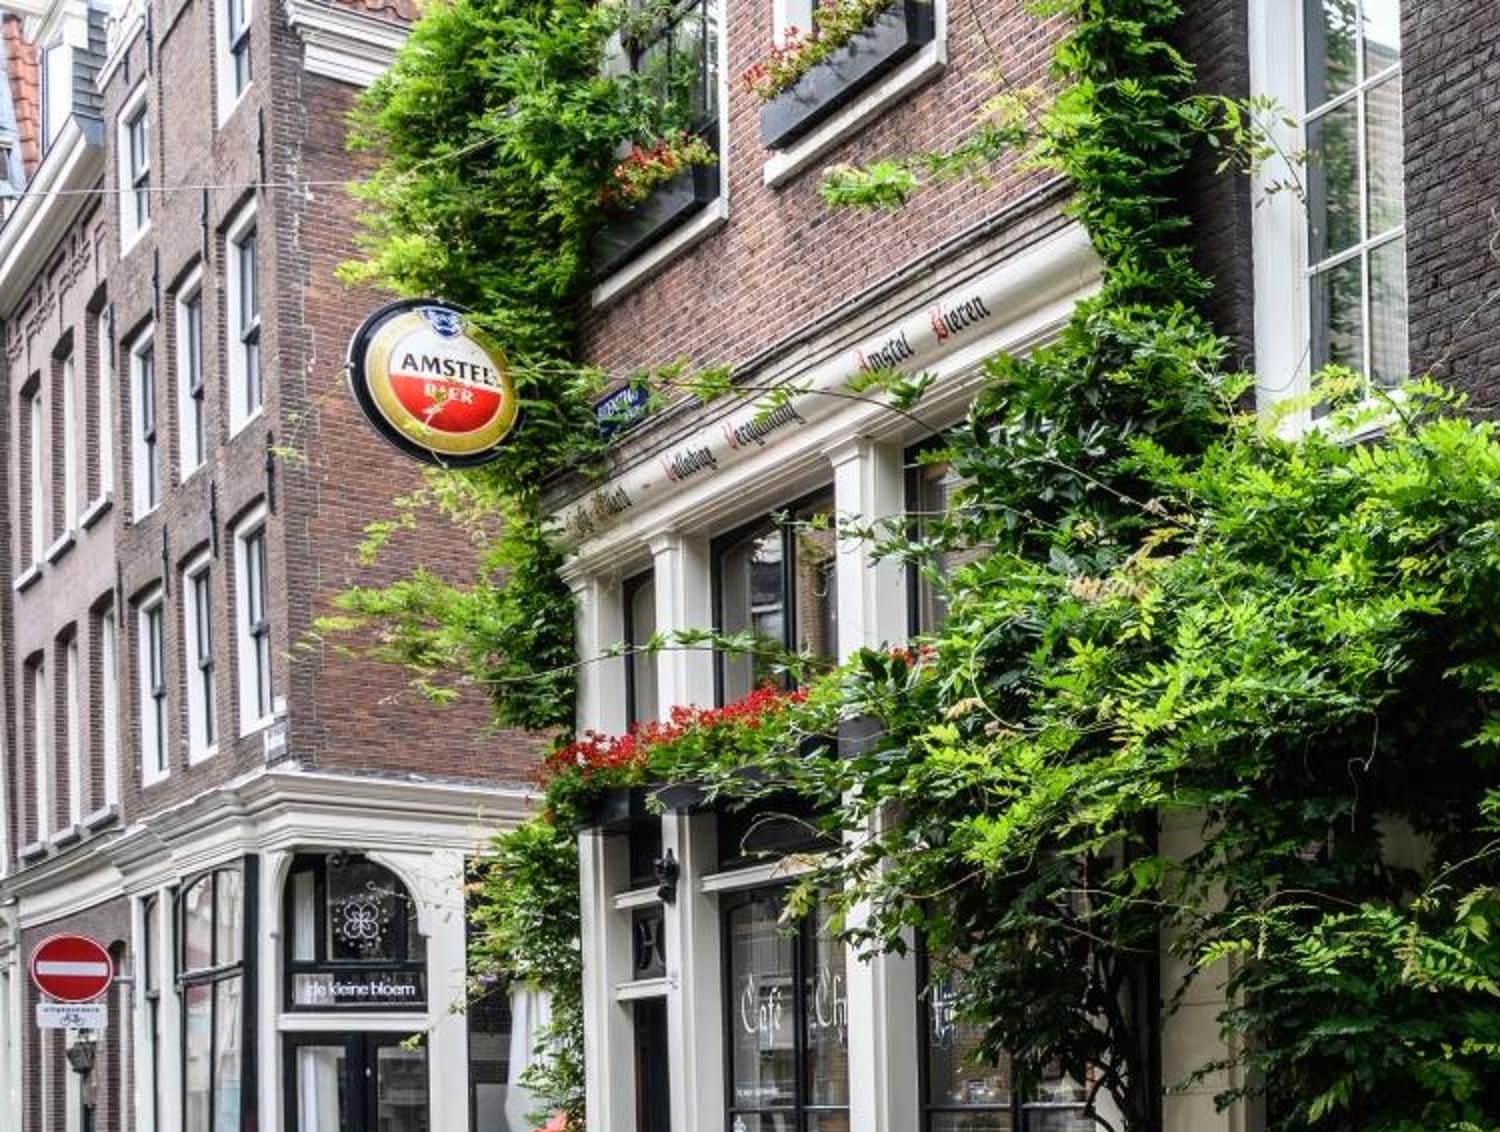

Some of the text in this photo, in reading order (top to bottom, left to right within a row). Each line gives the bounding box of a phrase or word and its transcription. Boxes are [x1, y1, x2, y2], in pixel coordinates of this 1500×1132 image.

[928, 295, 991, 345] Bieren
[401, 352, 497, 387] AMSTEL
[329, 981, 369, 996] kleine
[370, 981, 416, 996] bloem
[815, 967, 848, 1032] Ch
